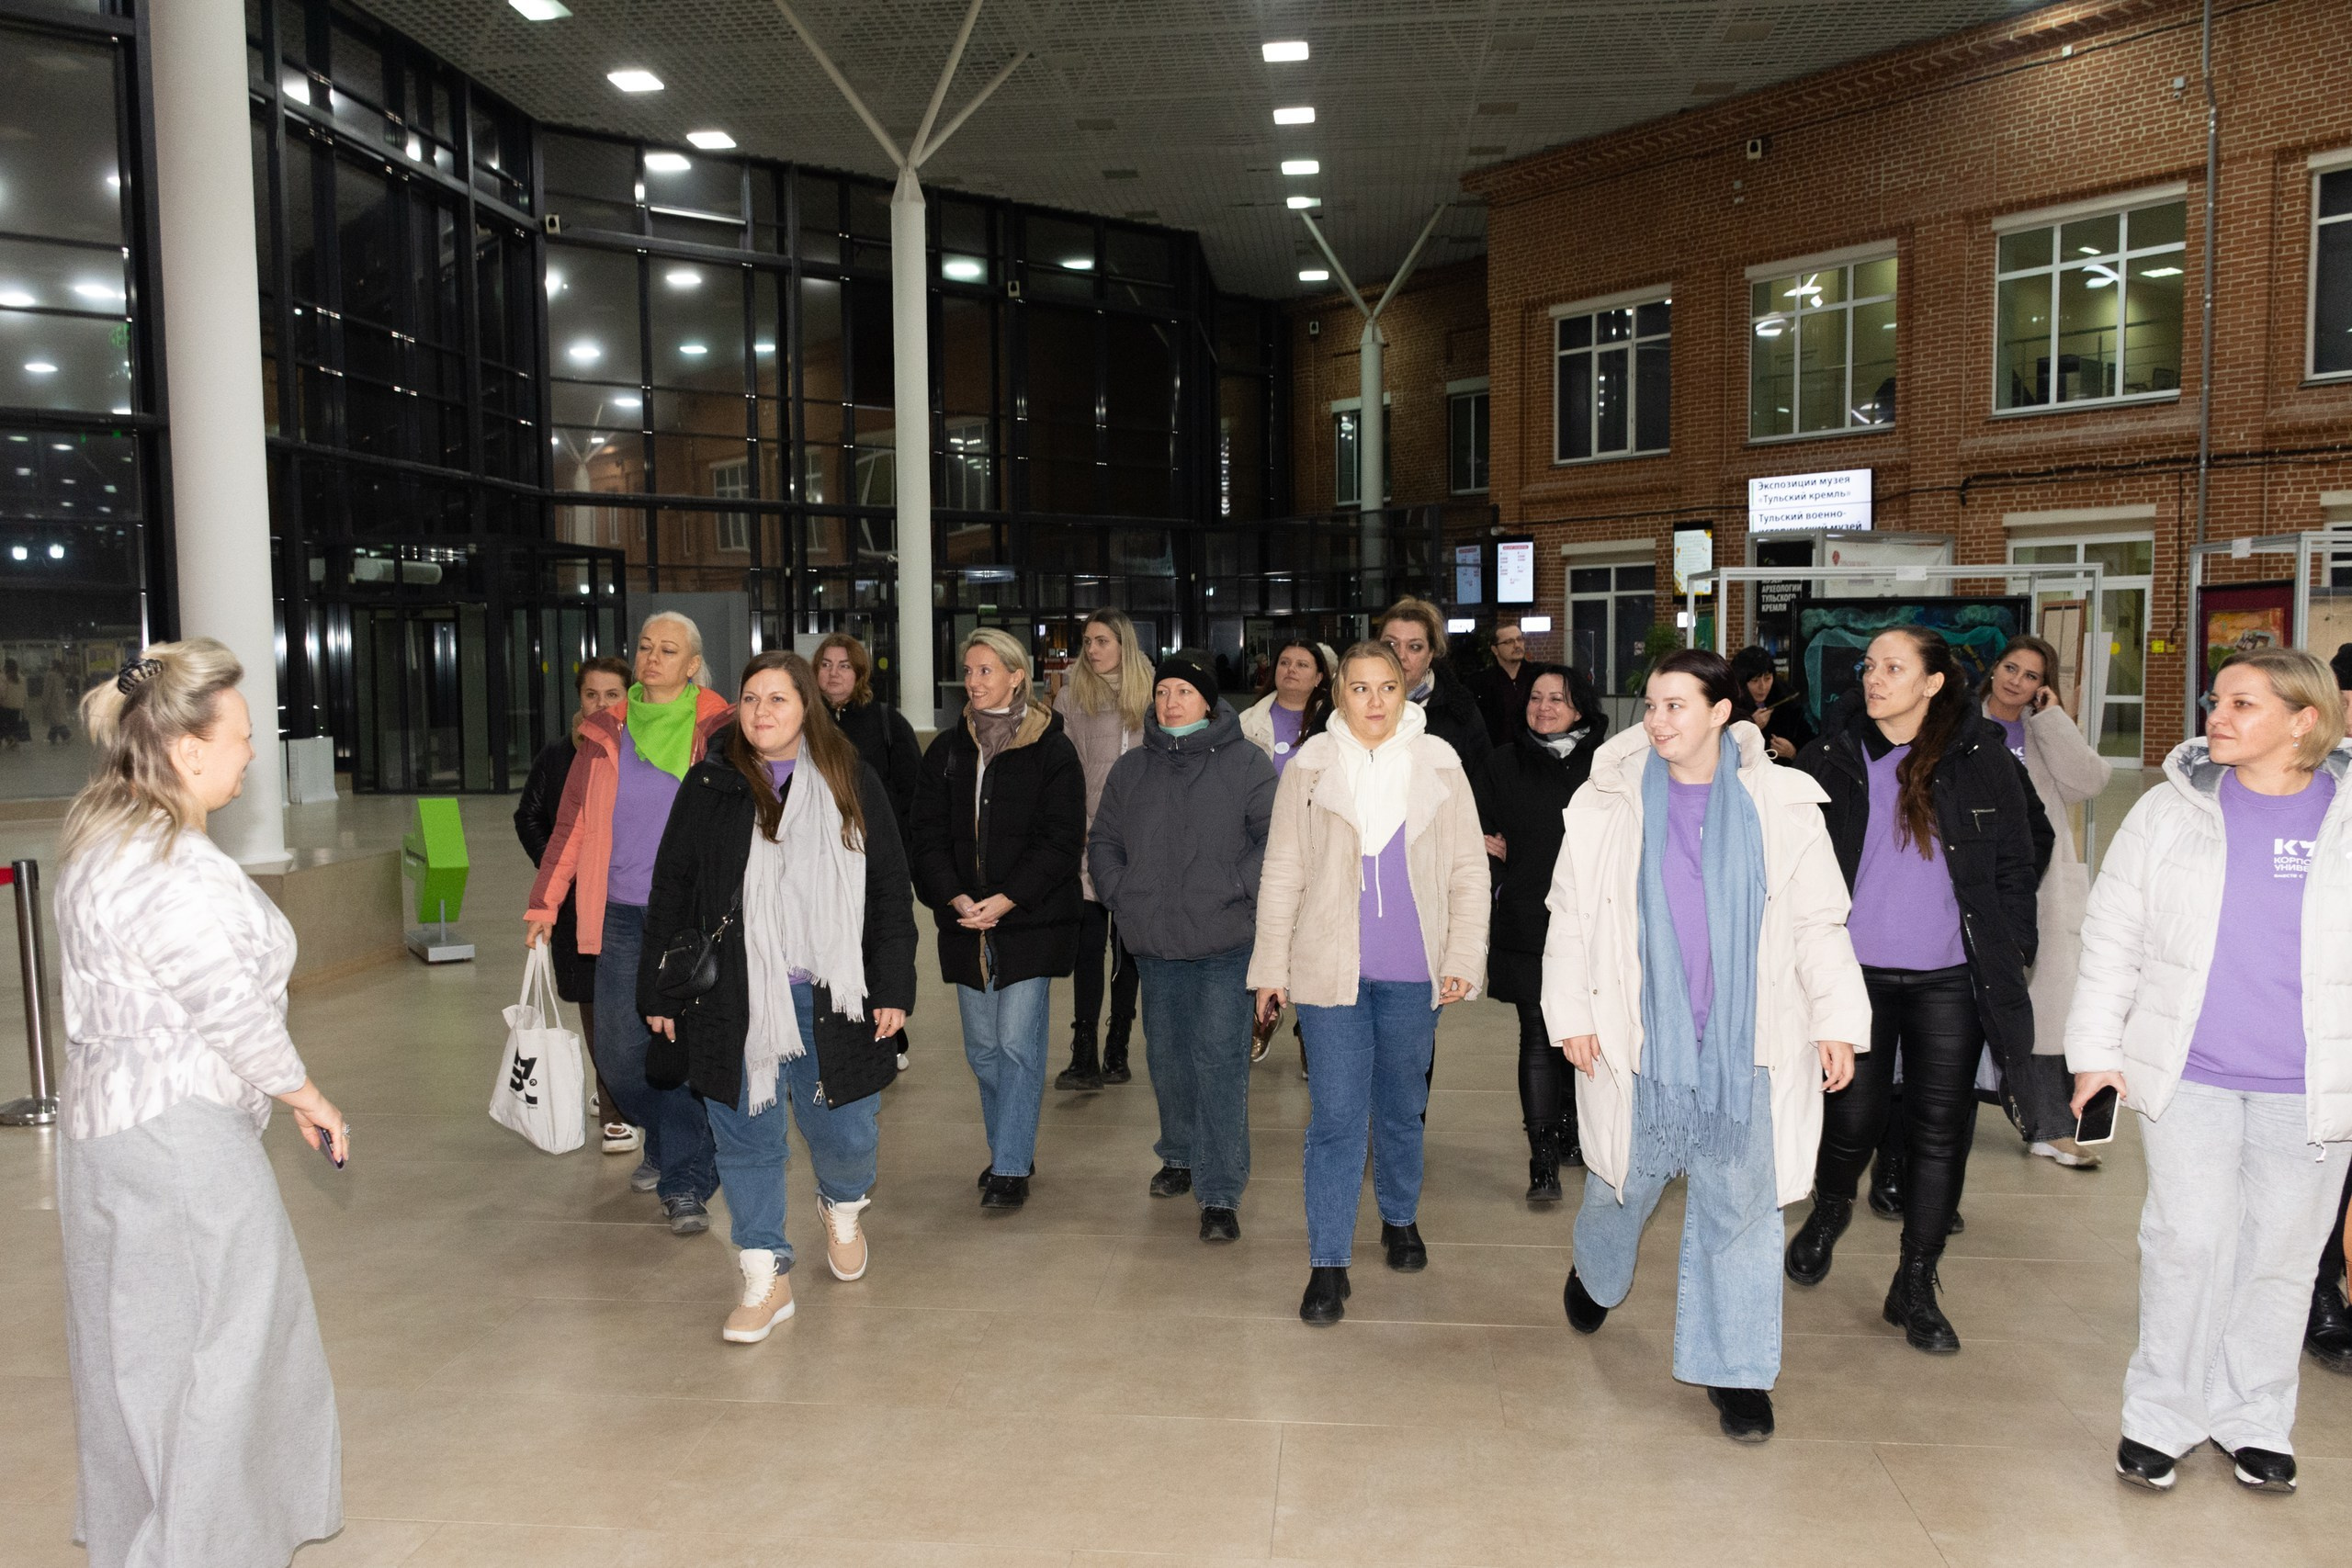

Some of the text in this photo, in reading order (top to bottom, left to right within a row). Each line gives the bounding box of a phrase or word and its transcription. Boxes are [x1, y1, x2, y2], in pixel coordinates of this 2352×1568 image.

[1758, 476, 1850, 491] Экспозиции музея
[1759, 511, 1847, 525] Тульский военно-
[1761, 584, 1802, 593] АРХЕОЛОГИИ
[1761, 604, 1787, 613] КРЕМЛЯ
